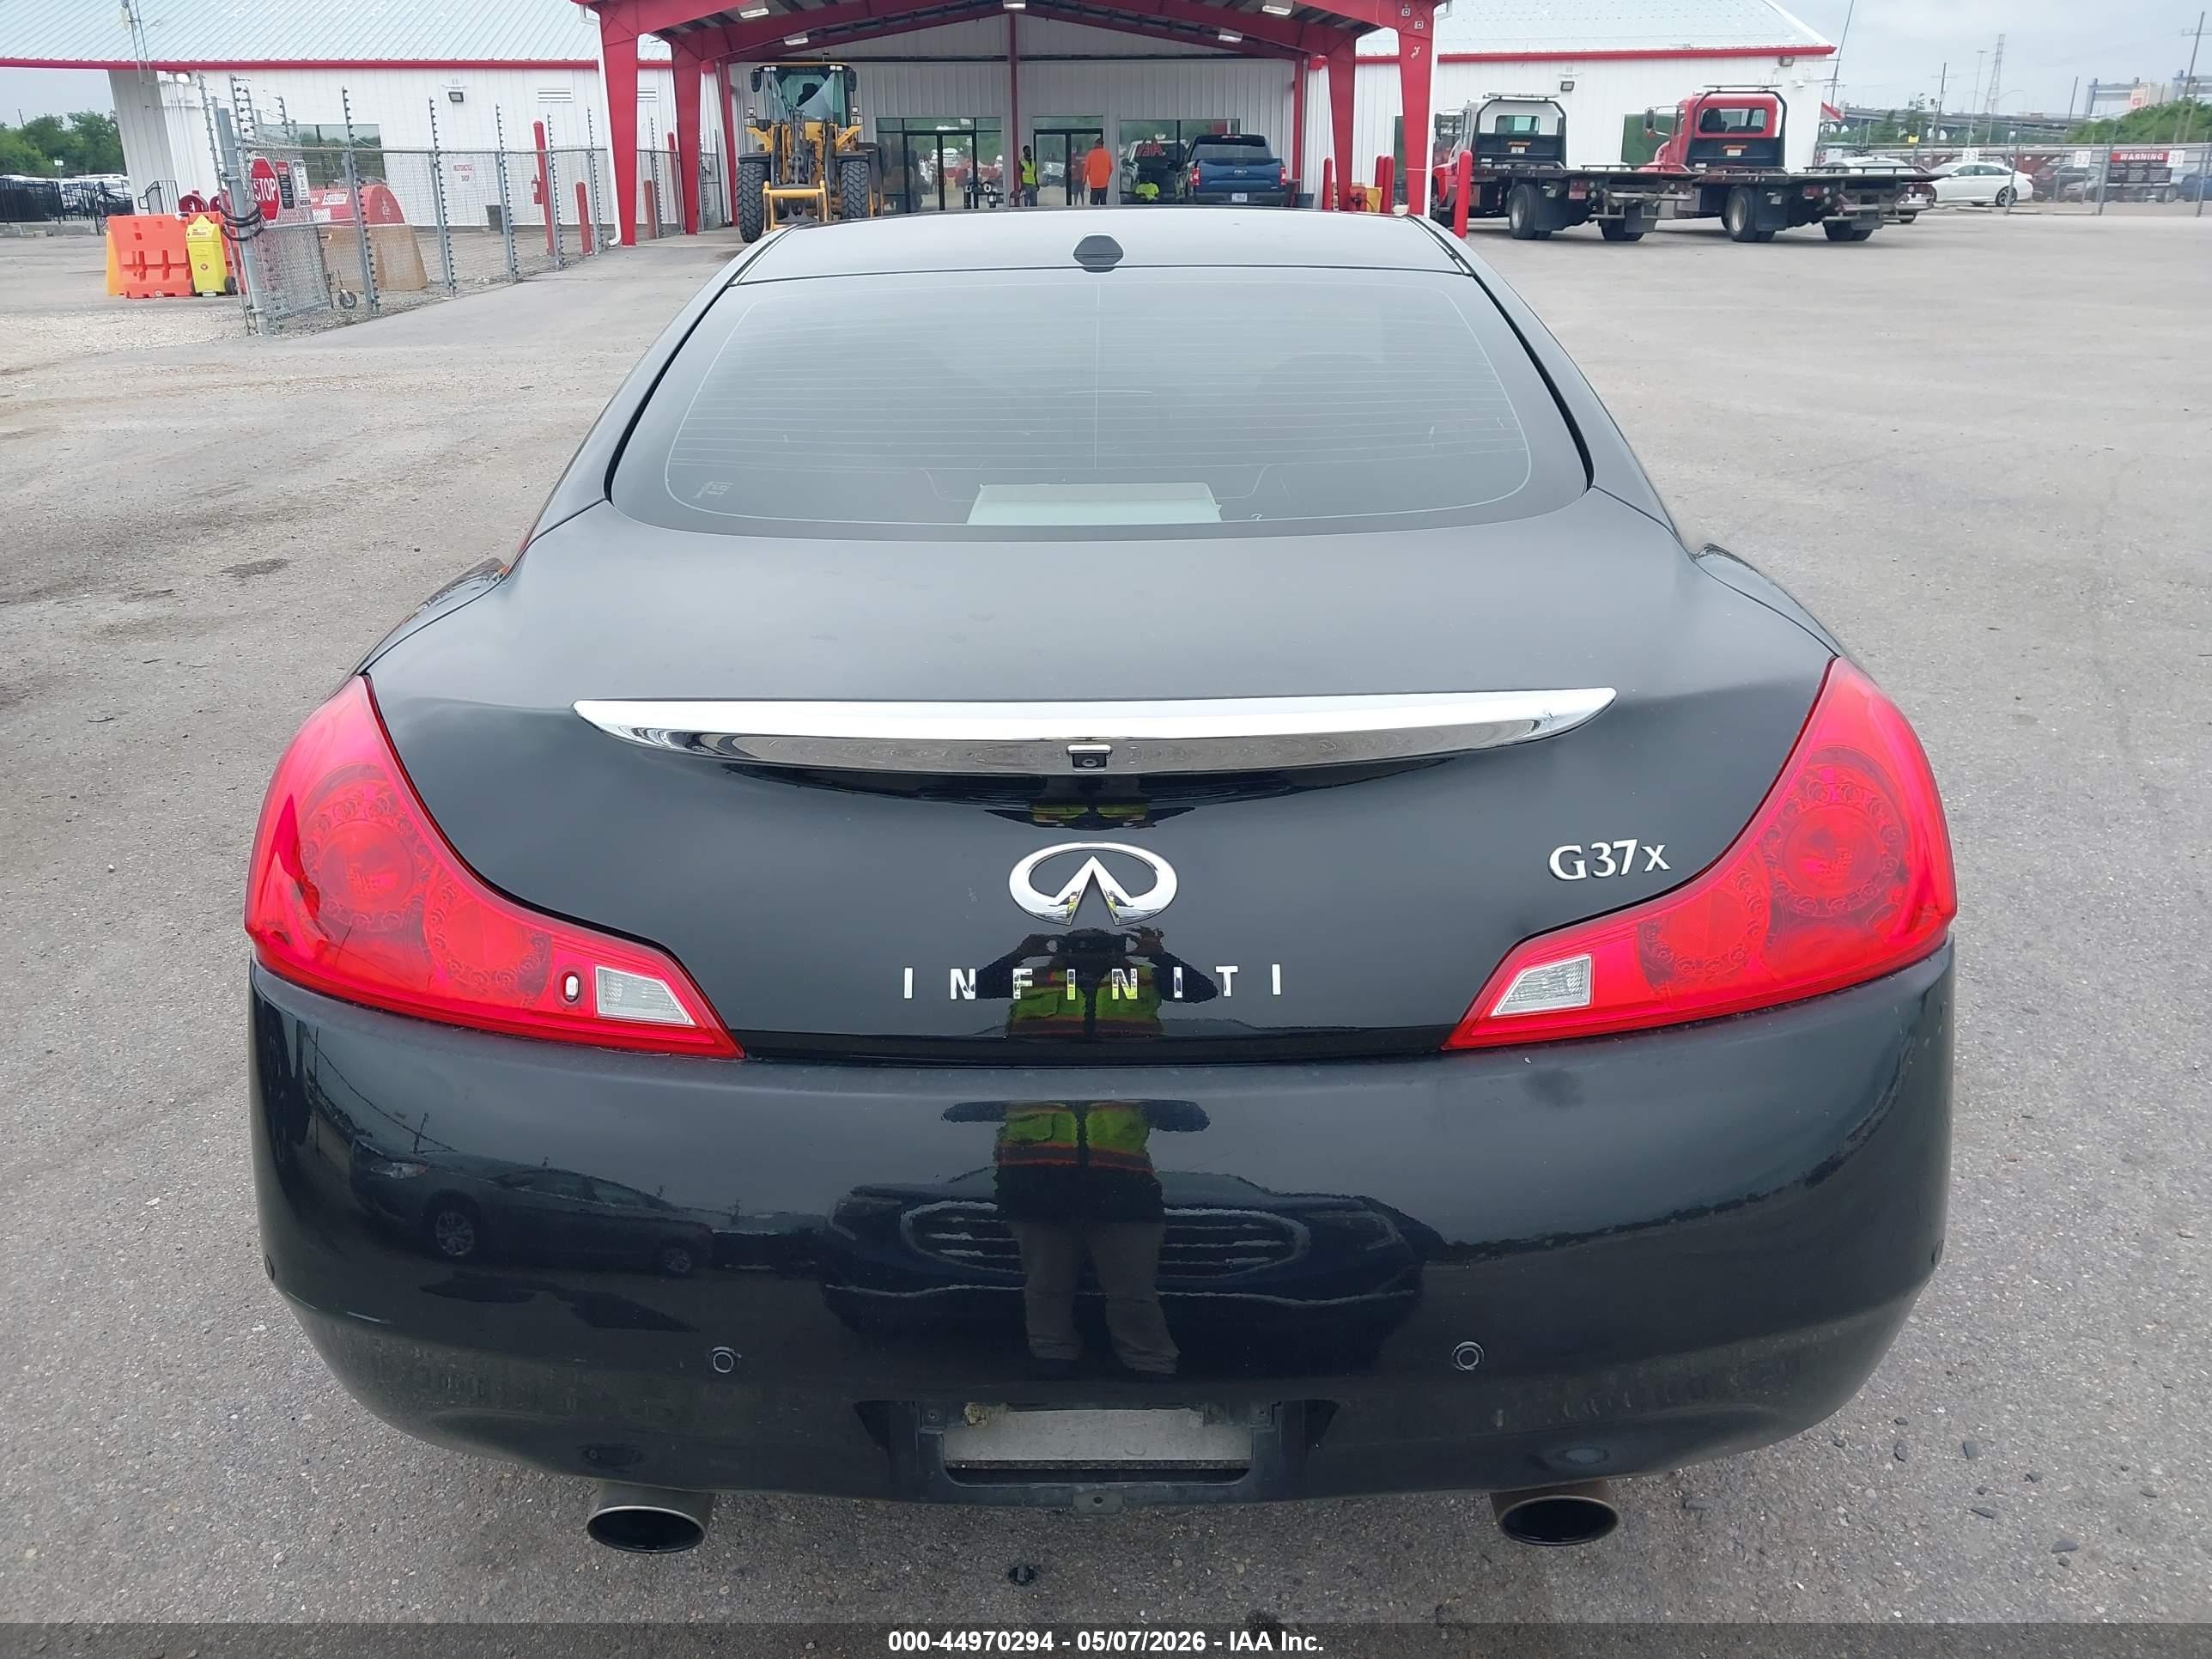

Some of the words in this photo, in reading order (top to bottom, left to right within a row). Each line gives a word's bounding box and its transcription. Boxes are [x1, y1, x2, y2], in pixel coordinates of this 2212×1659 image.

[2075, 153, 2088, 164] 32
[252, 178, 276, 201] STOP
[902, 963, 1282, 1000] INFINITI
